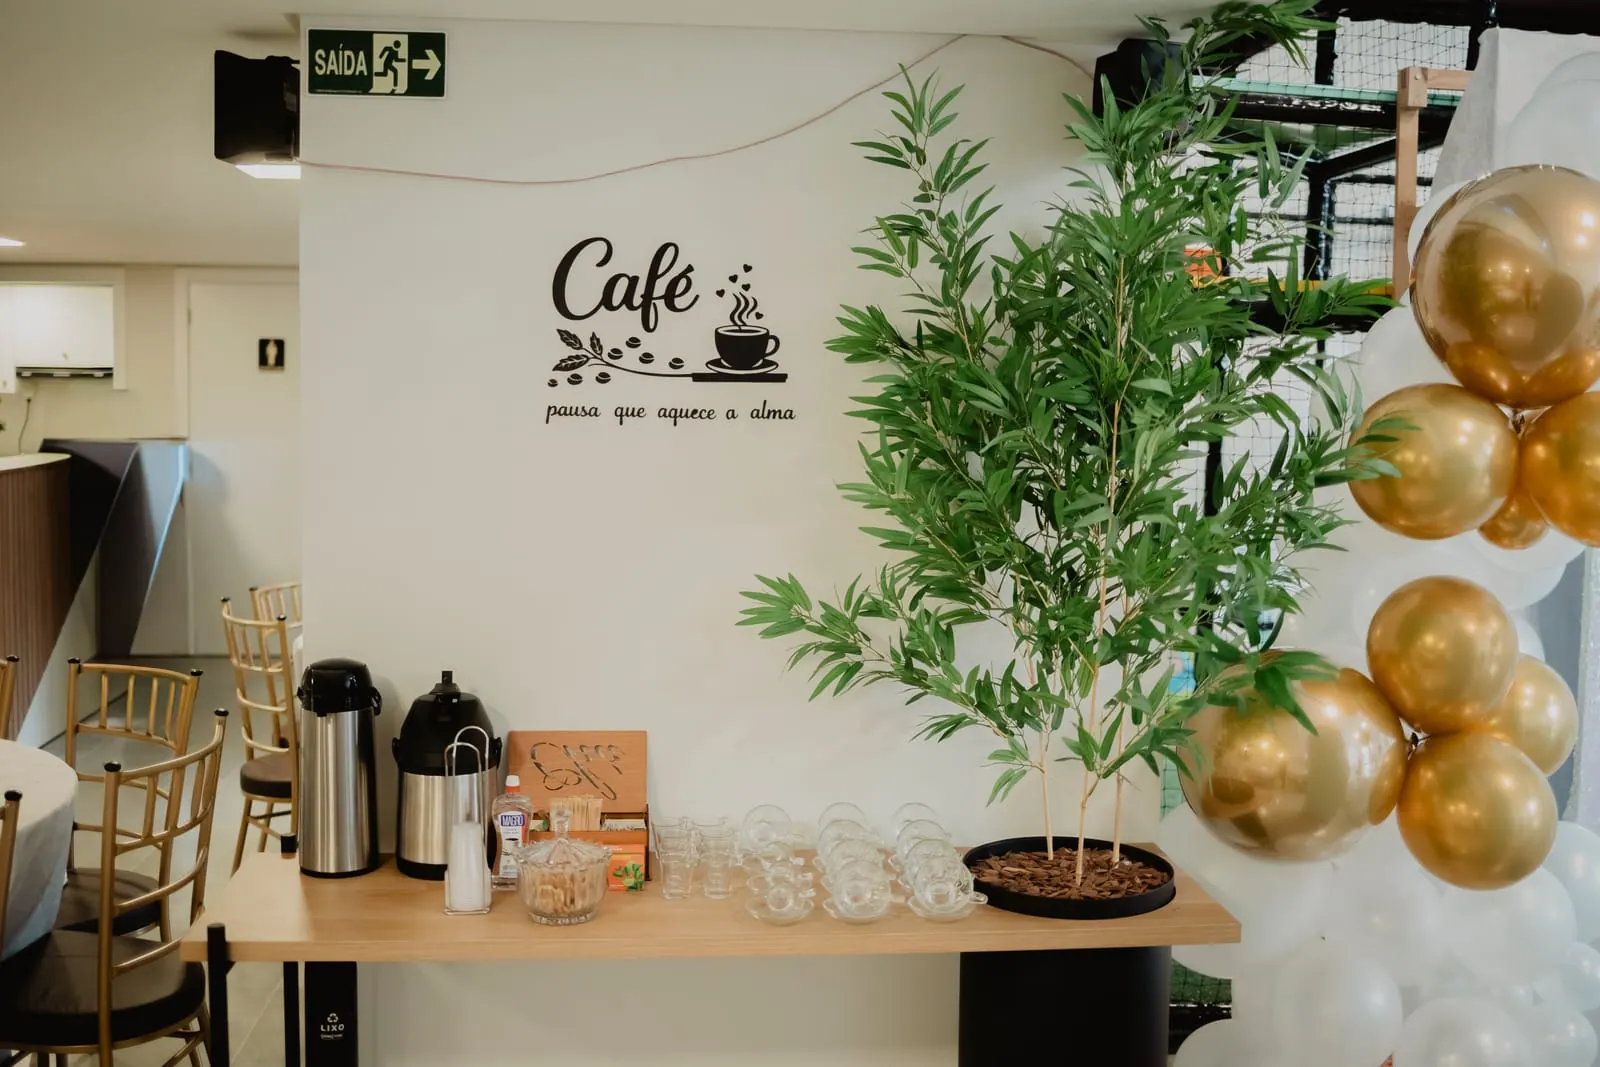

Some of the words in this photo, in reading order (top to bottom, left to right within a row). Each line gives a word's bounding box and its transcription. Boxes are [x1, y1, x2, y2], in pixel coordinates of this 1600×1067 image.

[314, 44, 368, 76] SAÍDA
[552, 237, 700, 333] Café
[546, 404, 601, 425] pausa
[614, 405, 647, 426] que
[657, 405, 717, 427] aquece
[725, 407, 739, 420] a
[750, 400, 796, 420] alma
[320, 1024, 345, 1032] LIXO
